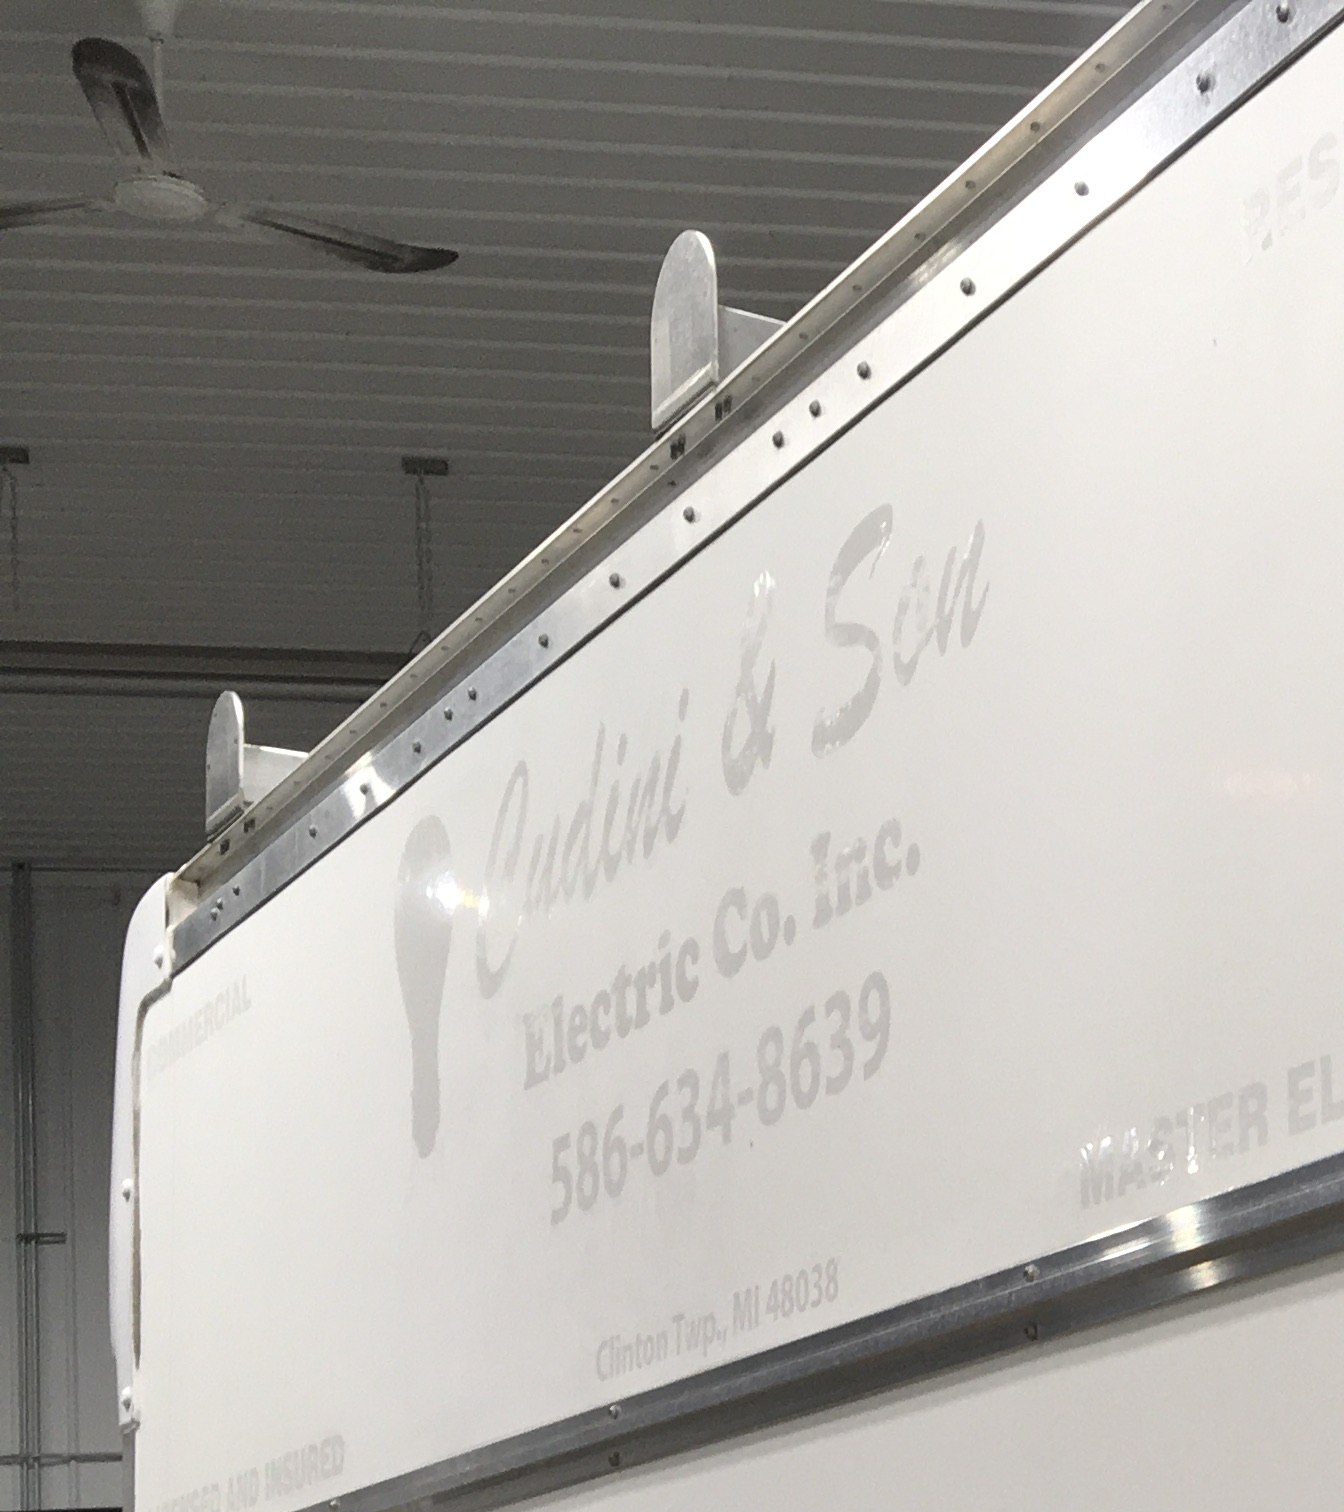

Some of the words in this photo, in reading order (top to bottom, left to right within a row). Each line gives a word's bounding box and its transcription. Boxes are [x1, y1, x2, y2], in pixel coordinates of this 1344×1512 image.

[721, 569, 777, 796] &
[811, 502, 990, 759] Son
[522, 928, 700, 1091] Electric
[712, 885, 797, 979] Co.
[811, 817, 921, 930] Inc.
[550, 969, 892, 1227] 586-634-8639
[595, 1329, 669, 1382] Clinton
[732, 1284, 760, 1335] MI
[764, 1257, 840, 1321] 48038
[264, 1433, 345, 1502] INSURED
